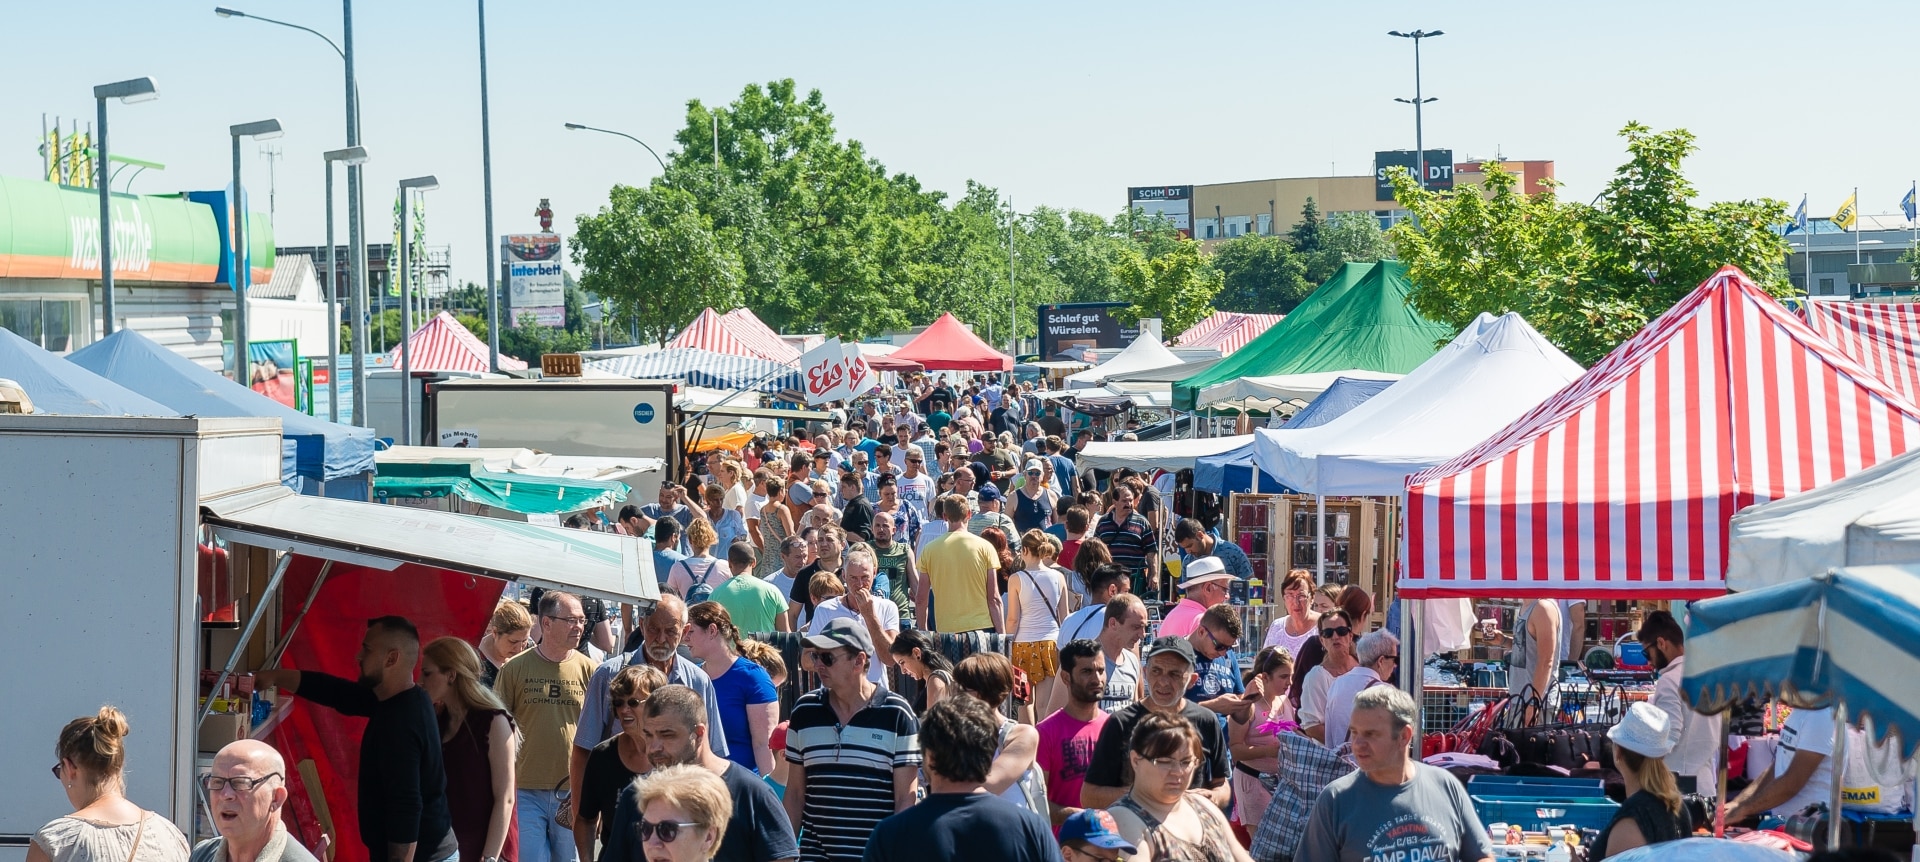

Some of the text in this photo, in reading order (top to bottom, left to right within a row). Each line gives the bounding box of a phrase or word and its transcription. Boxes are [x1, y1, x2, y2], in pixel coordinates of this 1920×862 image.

[511, 263, 561, 277] interbett
[1048, 314, 1100, 325] Schlaf gut
[1048, 326, 1101, 335] Würselen.
[808, 358, 843, 394] Eis
[548, 685, 561, 698] B
